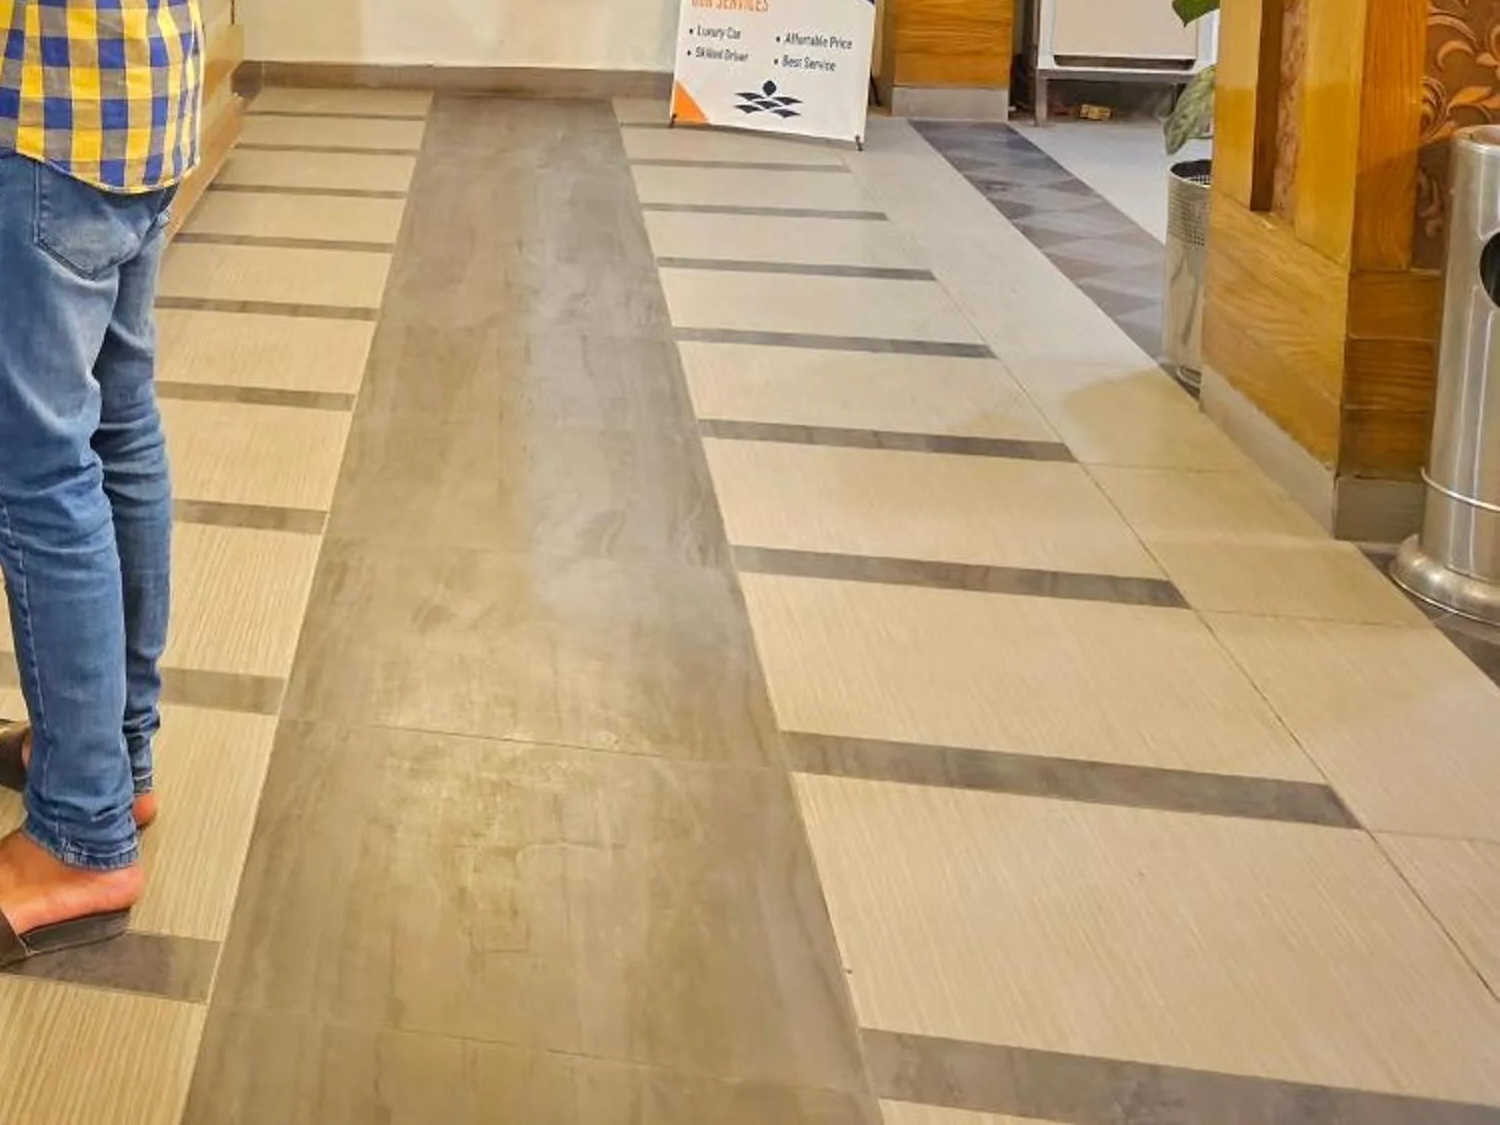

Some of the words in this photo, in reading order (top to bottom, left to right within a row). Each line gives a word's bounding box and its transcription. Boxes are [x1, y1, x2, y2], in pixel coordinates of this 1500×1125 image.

[697, 25, 725, 40] Luxury
[726, 27, 741, 40] Car
[829, 36, 852, 50] Price
[782, 54, 803, 68] Best
[804, 56, 837, 72] Service
